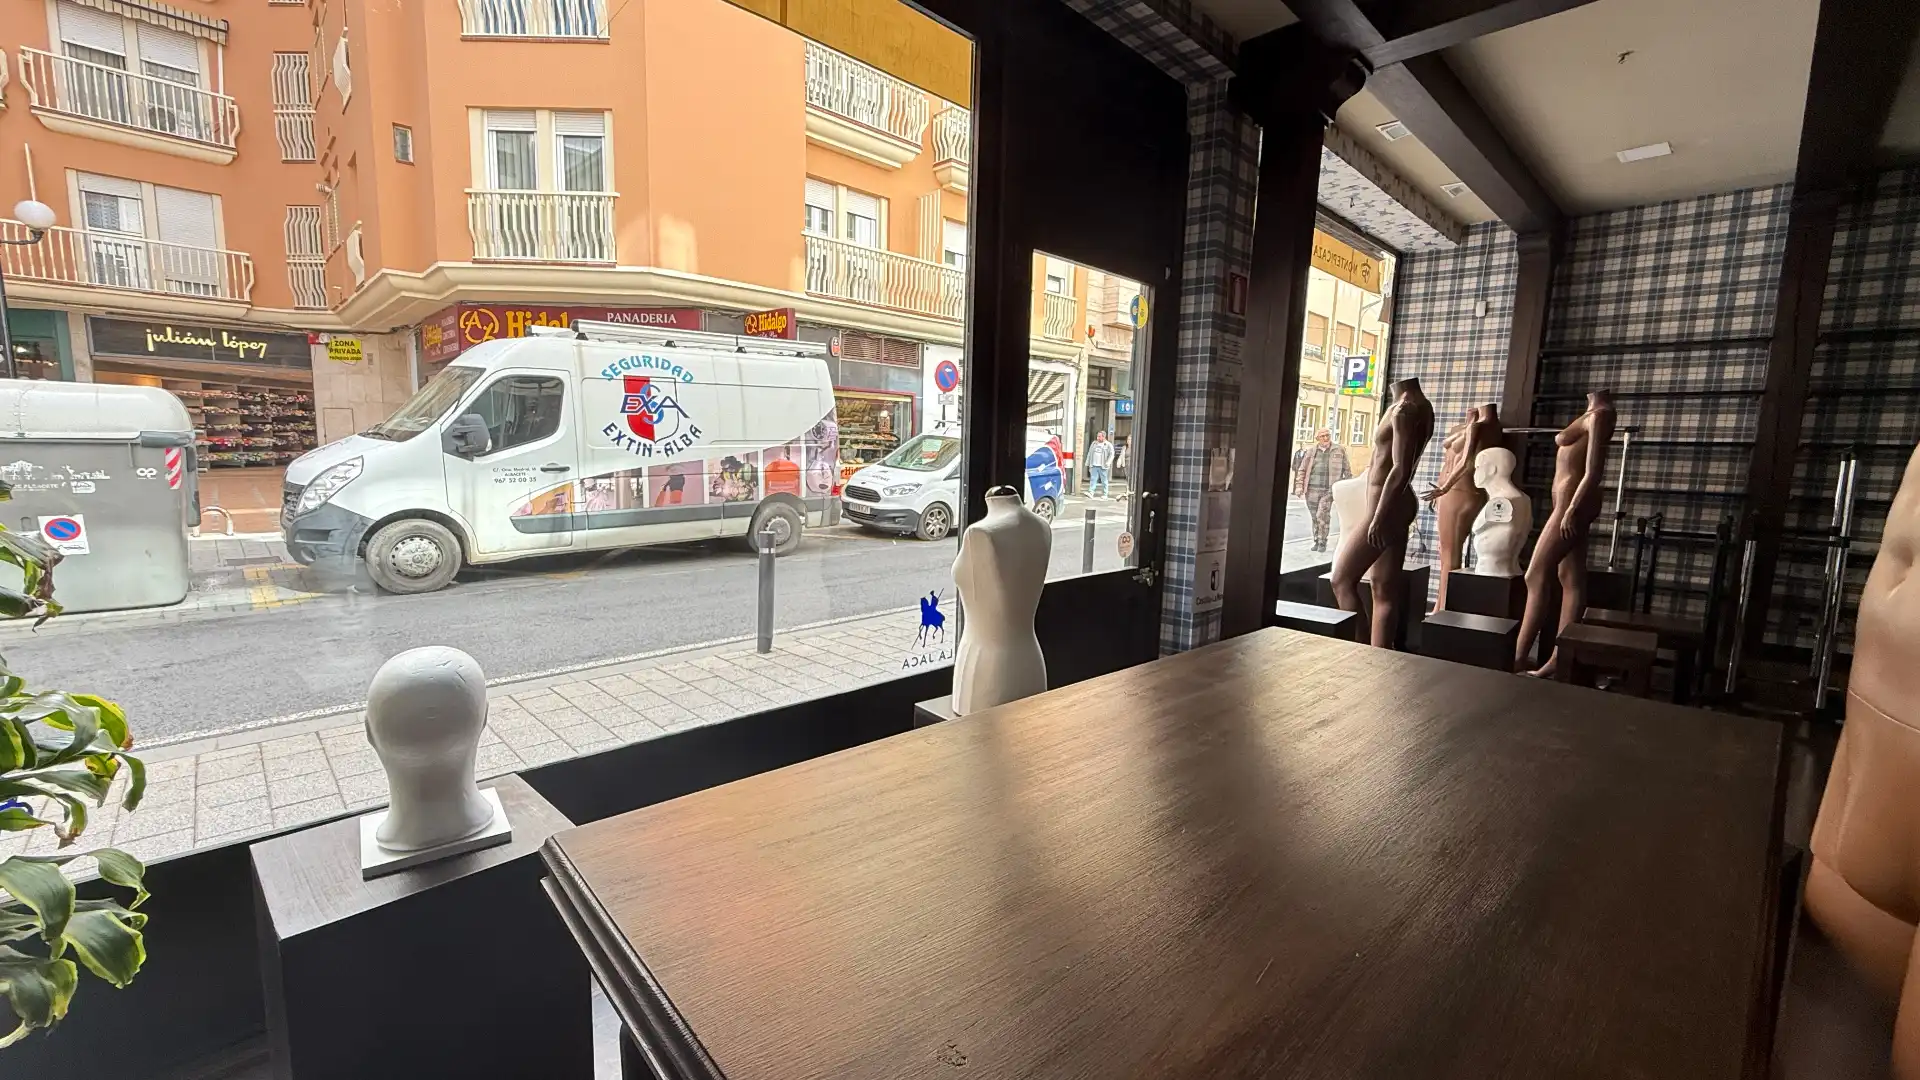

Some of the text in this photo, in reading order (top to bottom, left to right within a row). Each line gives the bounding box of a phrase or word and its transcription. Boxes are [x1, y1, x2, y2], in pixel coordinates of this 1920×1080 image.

[607, 312, 677, 324] PANADERIA
[758, 311, 787, 333] Hidalgo
[329, 347, 362, 355] PRIVADA
[601, 355, 694, 384] SEGURIDAD
[1347, 358, 1366, 380] P
[602, 422, 702, 458] EXTIN-ALBA
